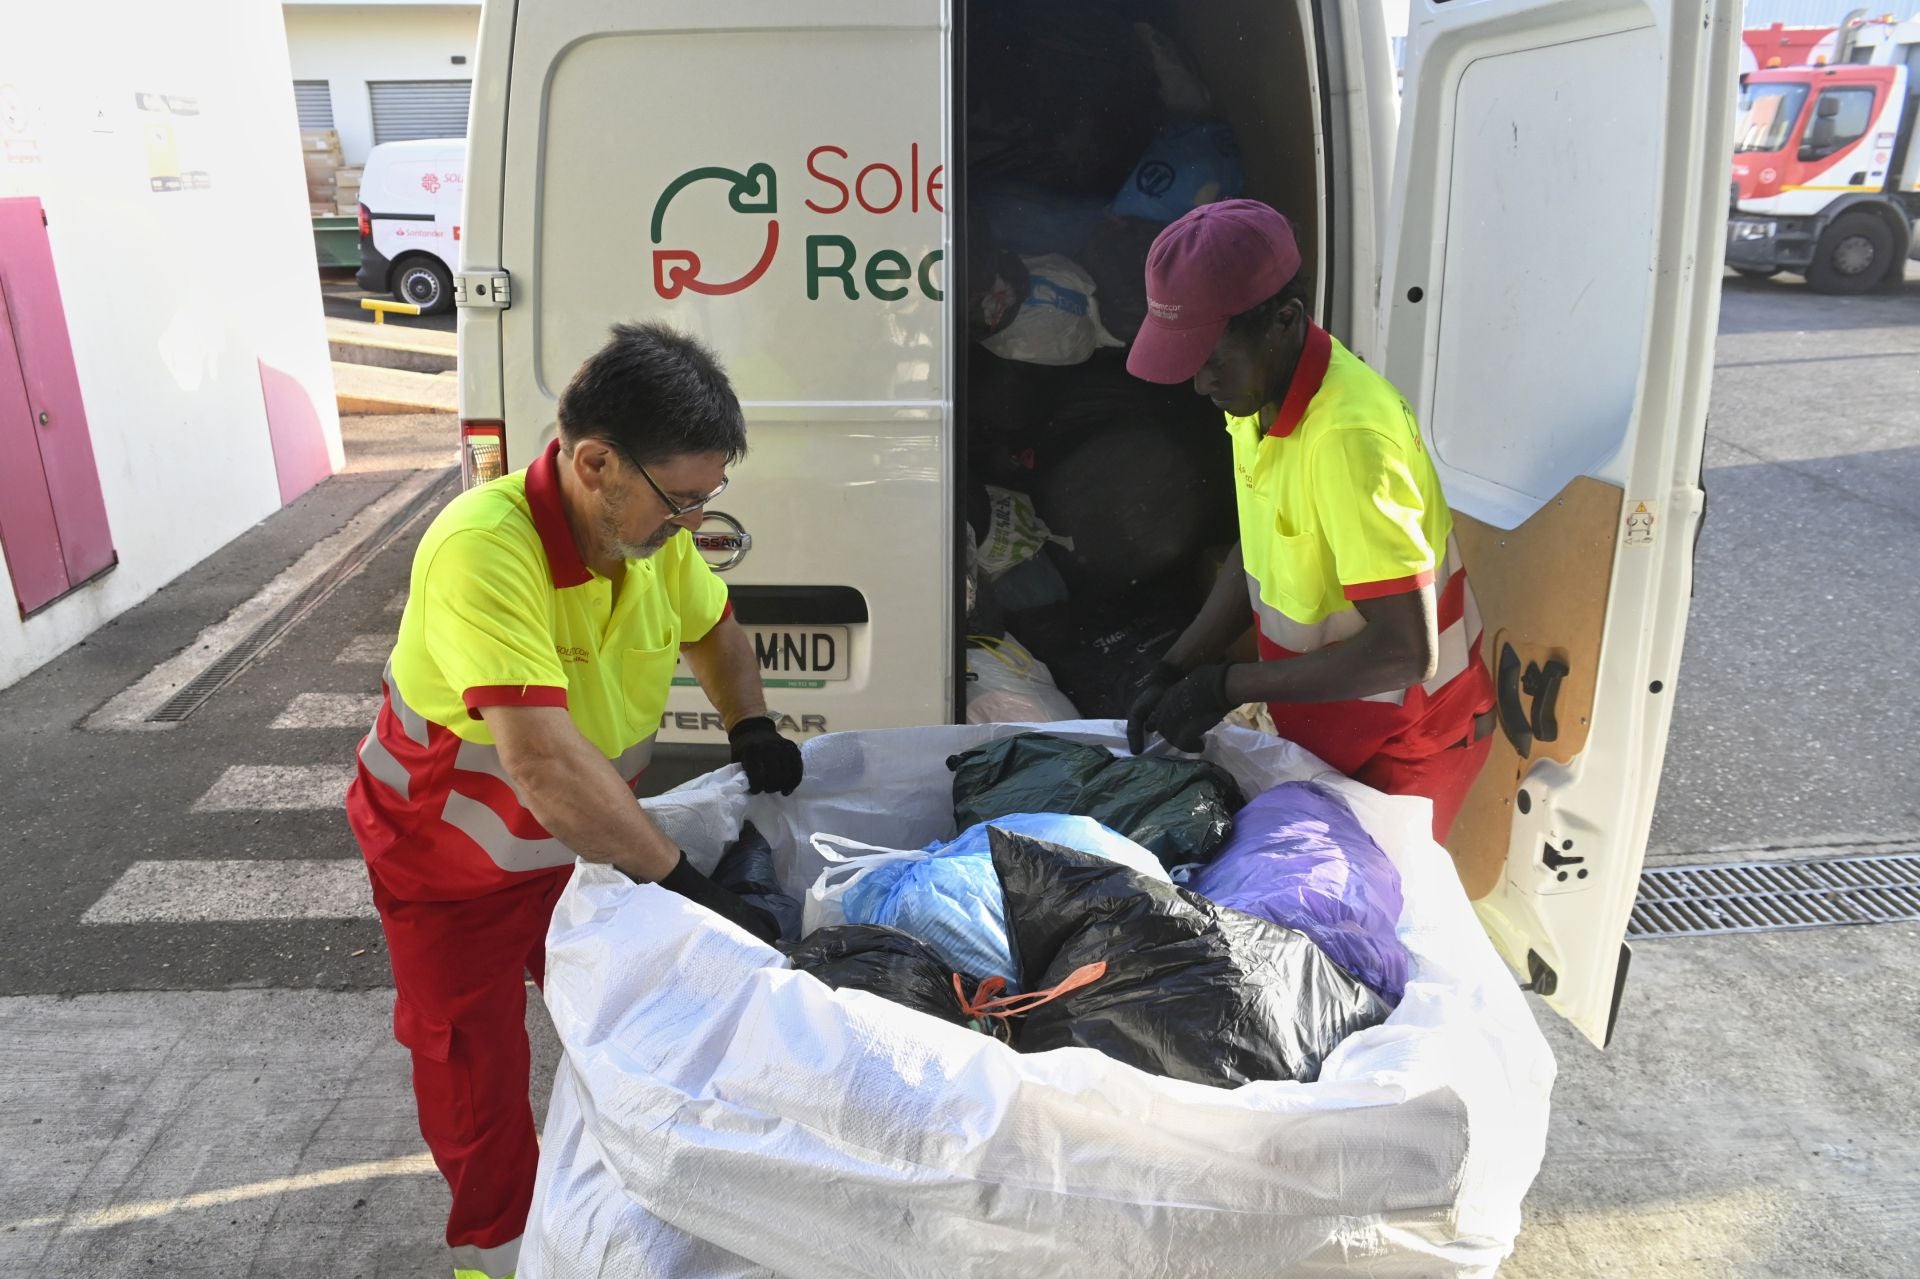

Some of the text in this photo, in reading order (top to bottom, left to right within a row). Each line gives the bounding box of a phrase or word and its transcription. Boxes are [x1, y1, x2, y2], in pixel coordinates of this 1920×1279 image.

[805, 234, 943, 301] Rec
[693, 536, 742, 547] ISSAN
[755, 632, 835, 671] MND
[660, 711, 827, 733] TERAR
